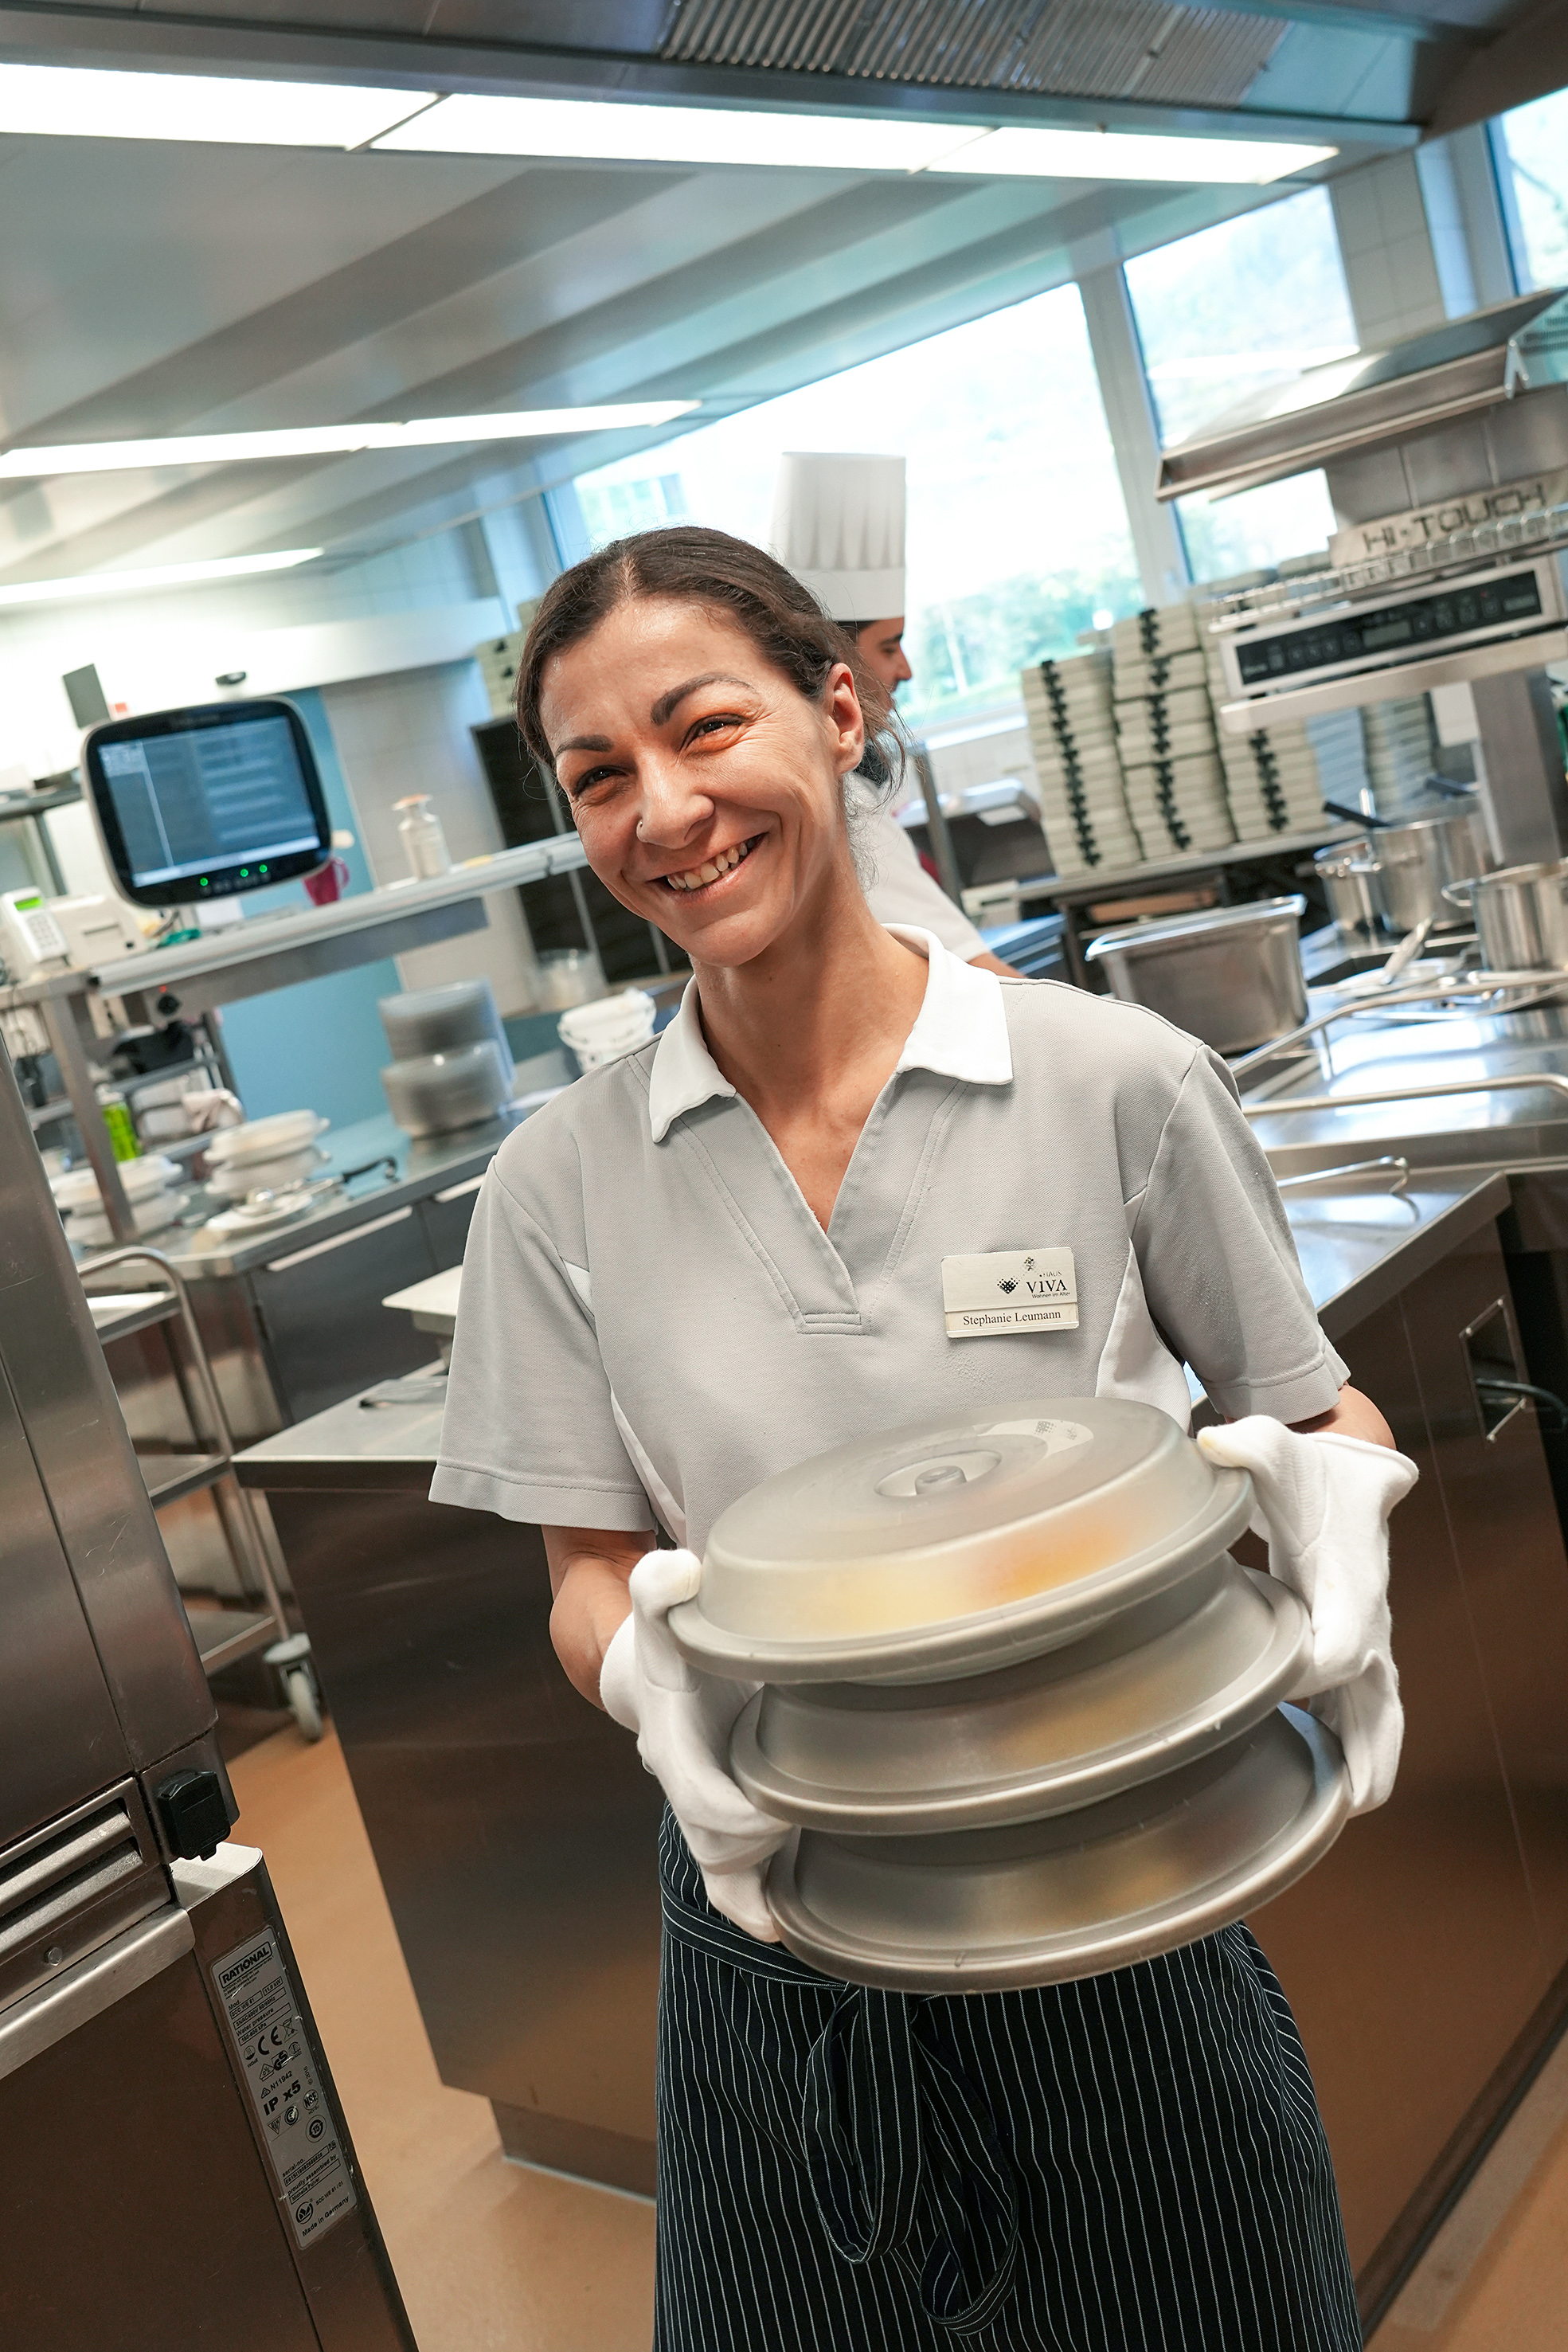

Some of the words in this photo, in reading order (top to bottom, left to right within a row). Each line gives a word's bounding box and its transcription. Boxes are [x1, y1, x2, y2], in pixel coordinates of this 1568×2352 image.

[1026, 1279, 1068, 1293] VIVA
[963, 1313, 1011, 1326] Stephanie
[1015, 1311, 1061, 1322] Leumann
[221, 1947, 269, 1984] RATIONAL
[228, 1999, 241, 2010] Mod.
[236, 2023, 251, 2037] Water
[252, 2008, 273, 2026] pressure
[270, 2070, 292, 2091] N11942
[263, 2096, 278, 2116] IP
[282, 2079, 301, 2102] x5
[303, 2091, 318, 2107] NSF
[312, 2123, 320, 2134] 15
[282, 2158, 305, 2178] serial-no.
[287, 2178, 305, 2196] proudly
[305, 2158, 330, 2181] assembled
[302, 2222, 317, 2237] Made
[324, 2196, 349, 2217] Germany
